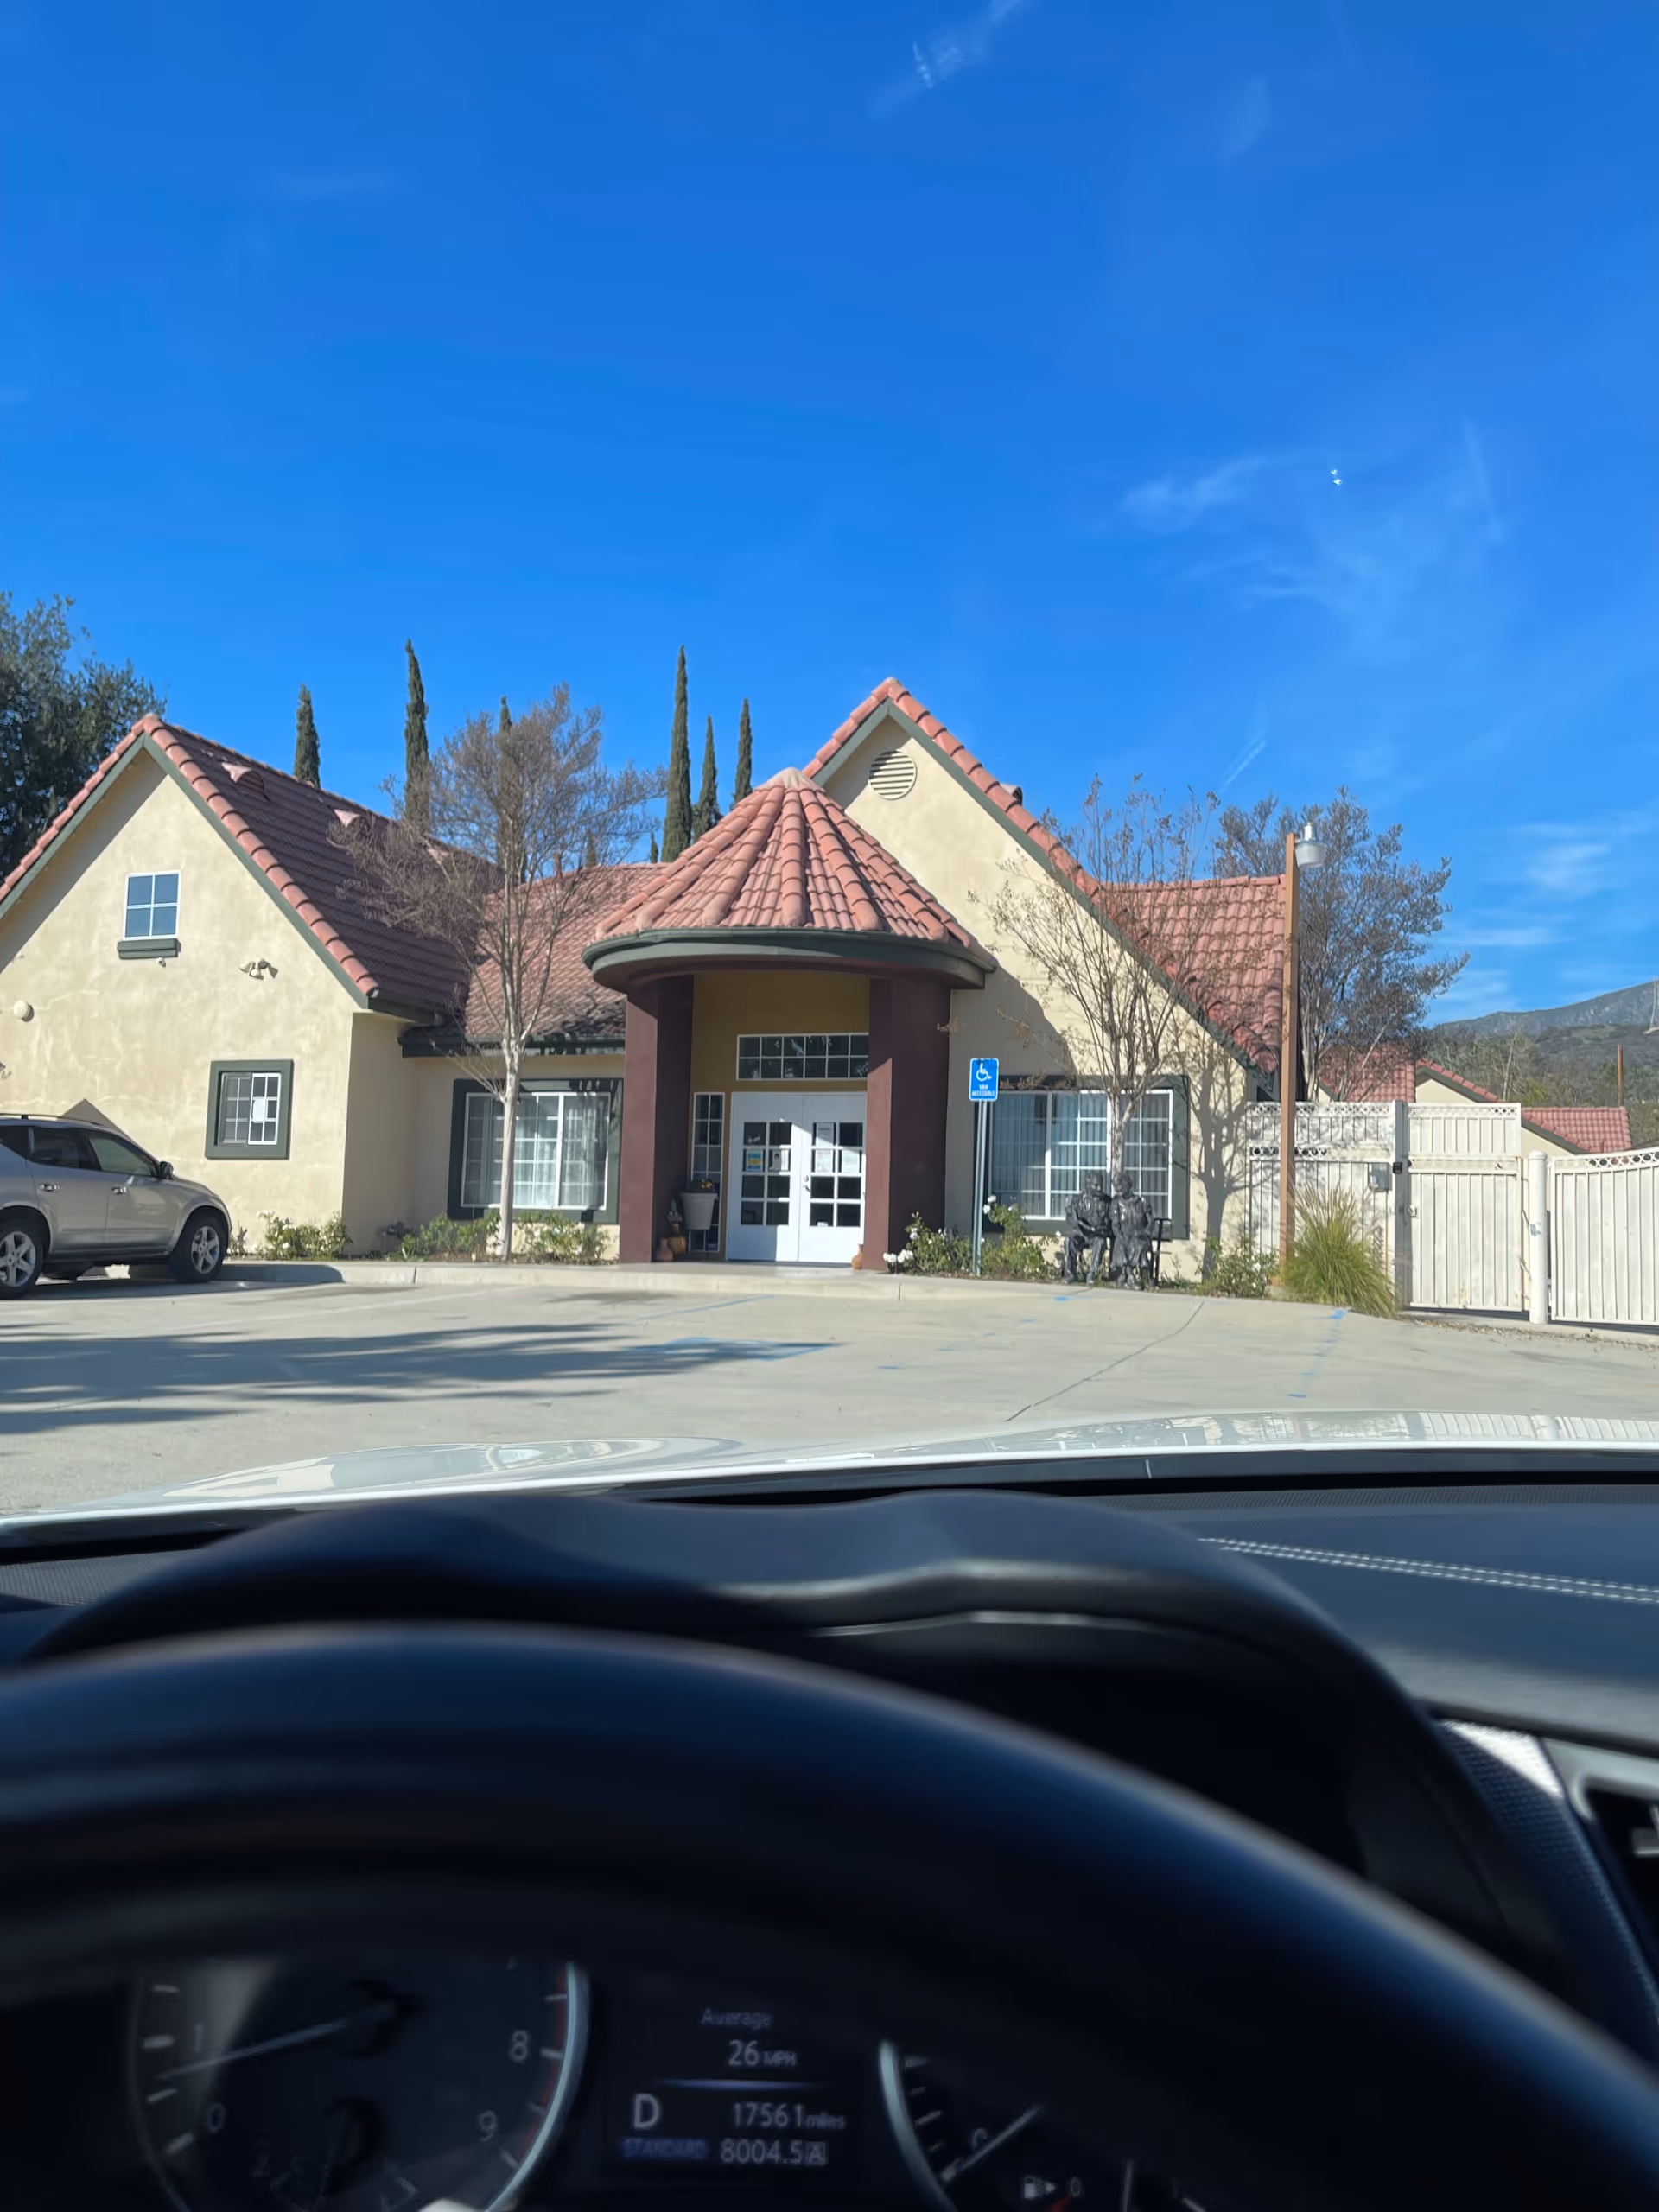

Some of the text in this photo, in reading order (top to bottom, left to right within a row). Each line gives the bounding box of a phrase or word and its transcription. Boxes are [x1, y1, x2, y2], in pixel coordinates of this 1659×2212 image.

[701, 2007, 772, 2030] Average
[508, 2029, 531, 2063] 8
[728, 2039, 797, 2067] 26 MPH
[207, 2102, 227, 2133] 0
[477, 2109, 499, 2142] 9
[633, 2093, 661, 2130] D
